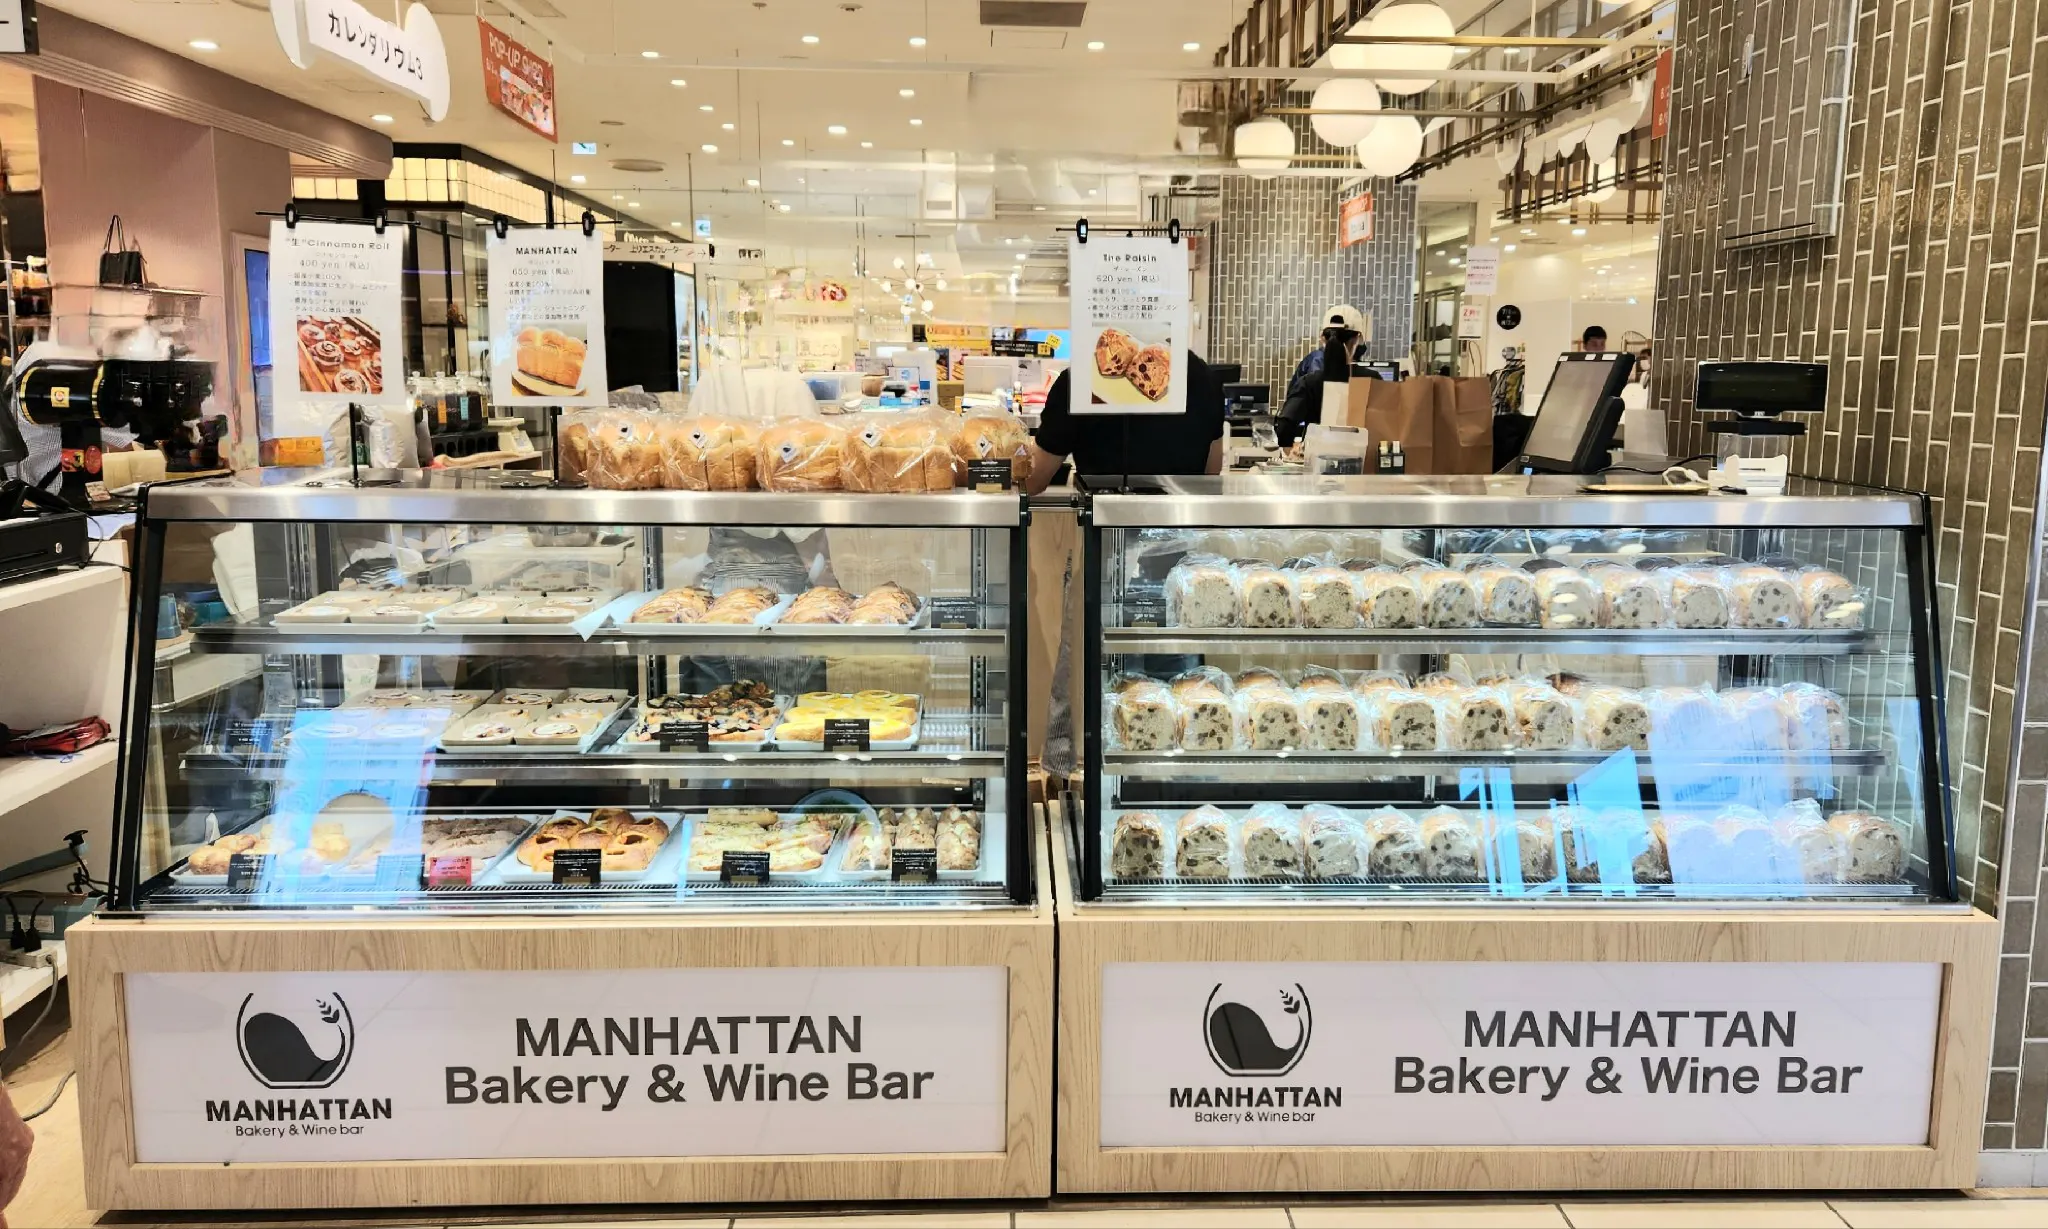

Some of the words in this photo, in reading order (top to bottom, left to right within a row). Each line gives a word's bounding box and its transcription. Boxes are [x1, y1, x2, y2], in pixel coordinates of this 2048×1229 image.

[488, 32, 520, 67] POP-UP
[515, 247, 578, 255] MANHATTAN
[1103, 254, 1122, 262] The
[1125, 254, 1158, 262] Raisin
[516, 1015, 862, 1057] MANHATTAN
[1465, 1011, 1797, 1048] MANHATTAN
[446, 1066, 630, 1112] Bakery
[648, 1064, 686, 1104] &
[703, 1063, 829, 1102] Wine
[848, 1062, 935, 1100] Bar
[1395, 1056, 1571, 1102] Bakery
[1586, 1056, 1623, 1095] &
[1641, 1056, 1760, 1095] Wine
[1778, 1056, 1864, 1094] Bar
[1169, 1087, 1342, 1108] MANHATTAN
[206, 1098, 392, 1122] MANHATTAN
[1195, 1111, 1242, 1124] Bakery
[1244, 1111, 1254, 1122] &
[1257, 1111, 1290, 1122] Wine
[1292, 1111, 1316, 1122] bar
[235, 1125, 285, 1139] Bakery
[288, 1125, 299, 1136] &
[301, 1124, 337, 1136] Wine
[339, 1124, 365, 1135] bar
